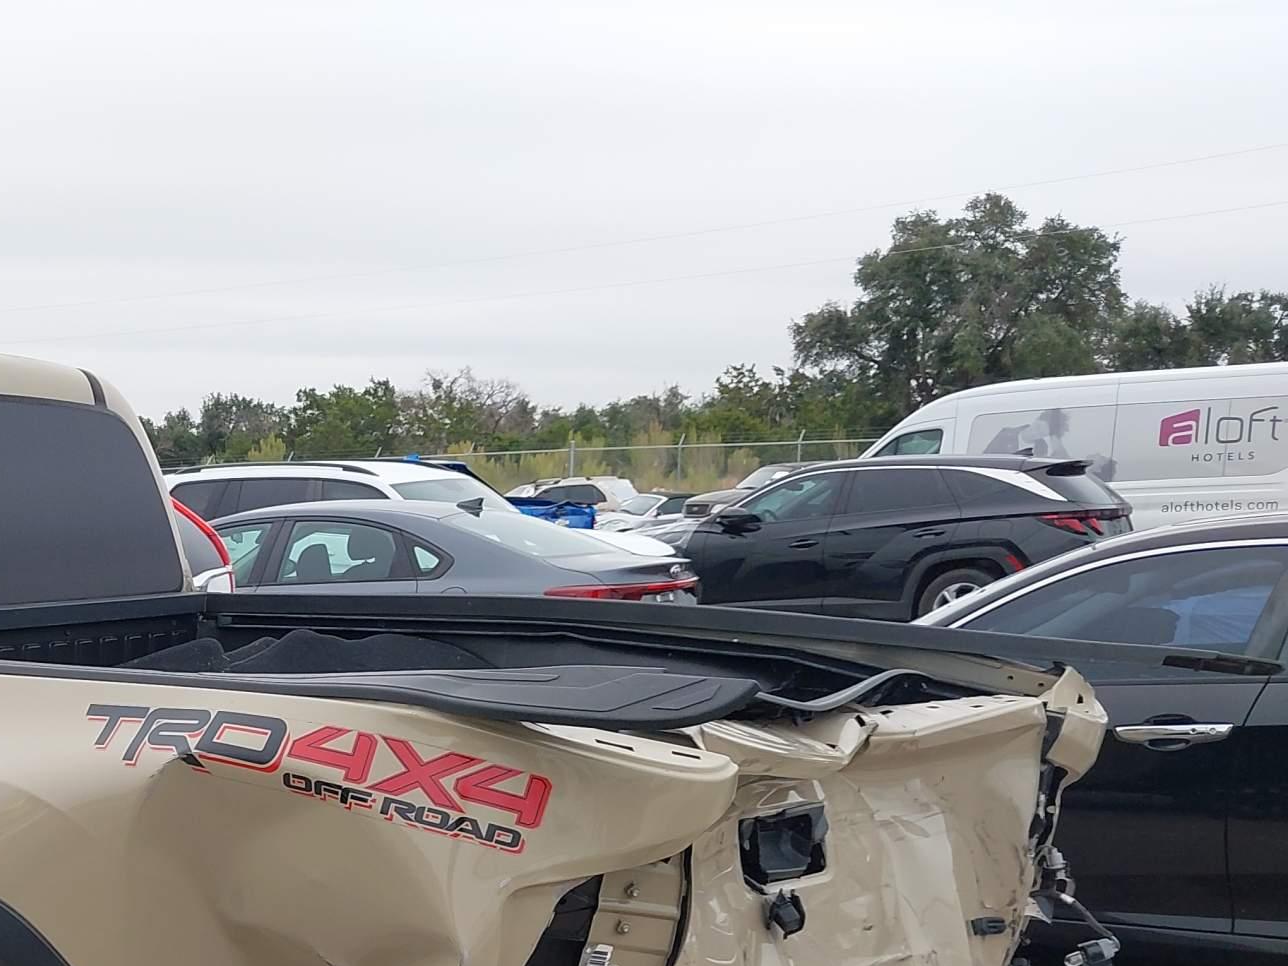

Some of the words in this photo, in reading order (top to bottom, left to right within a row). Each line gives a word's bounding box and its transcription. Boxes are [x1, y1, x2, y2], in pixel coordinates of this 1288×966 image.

[1158, 406, 1283, 447] aloft
[1191, 451, 1256, 463] HOTELS
[1161, 500, 1280, 514] alofthotels.com
[86, 703, 292, 773] TRD
[287, 725, 554, 830] 4X4
[282, 772, 376, 812] OFF
[379, 795, 528, 855] ROAD
